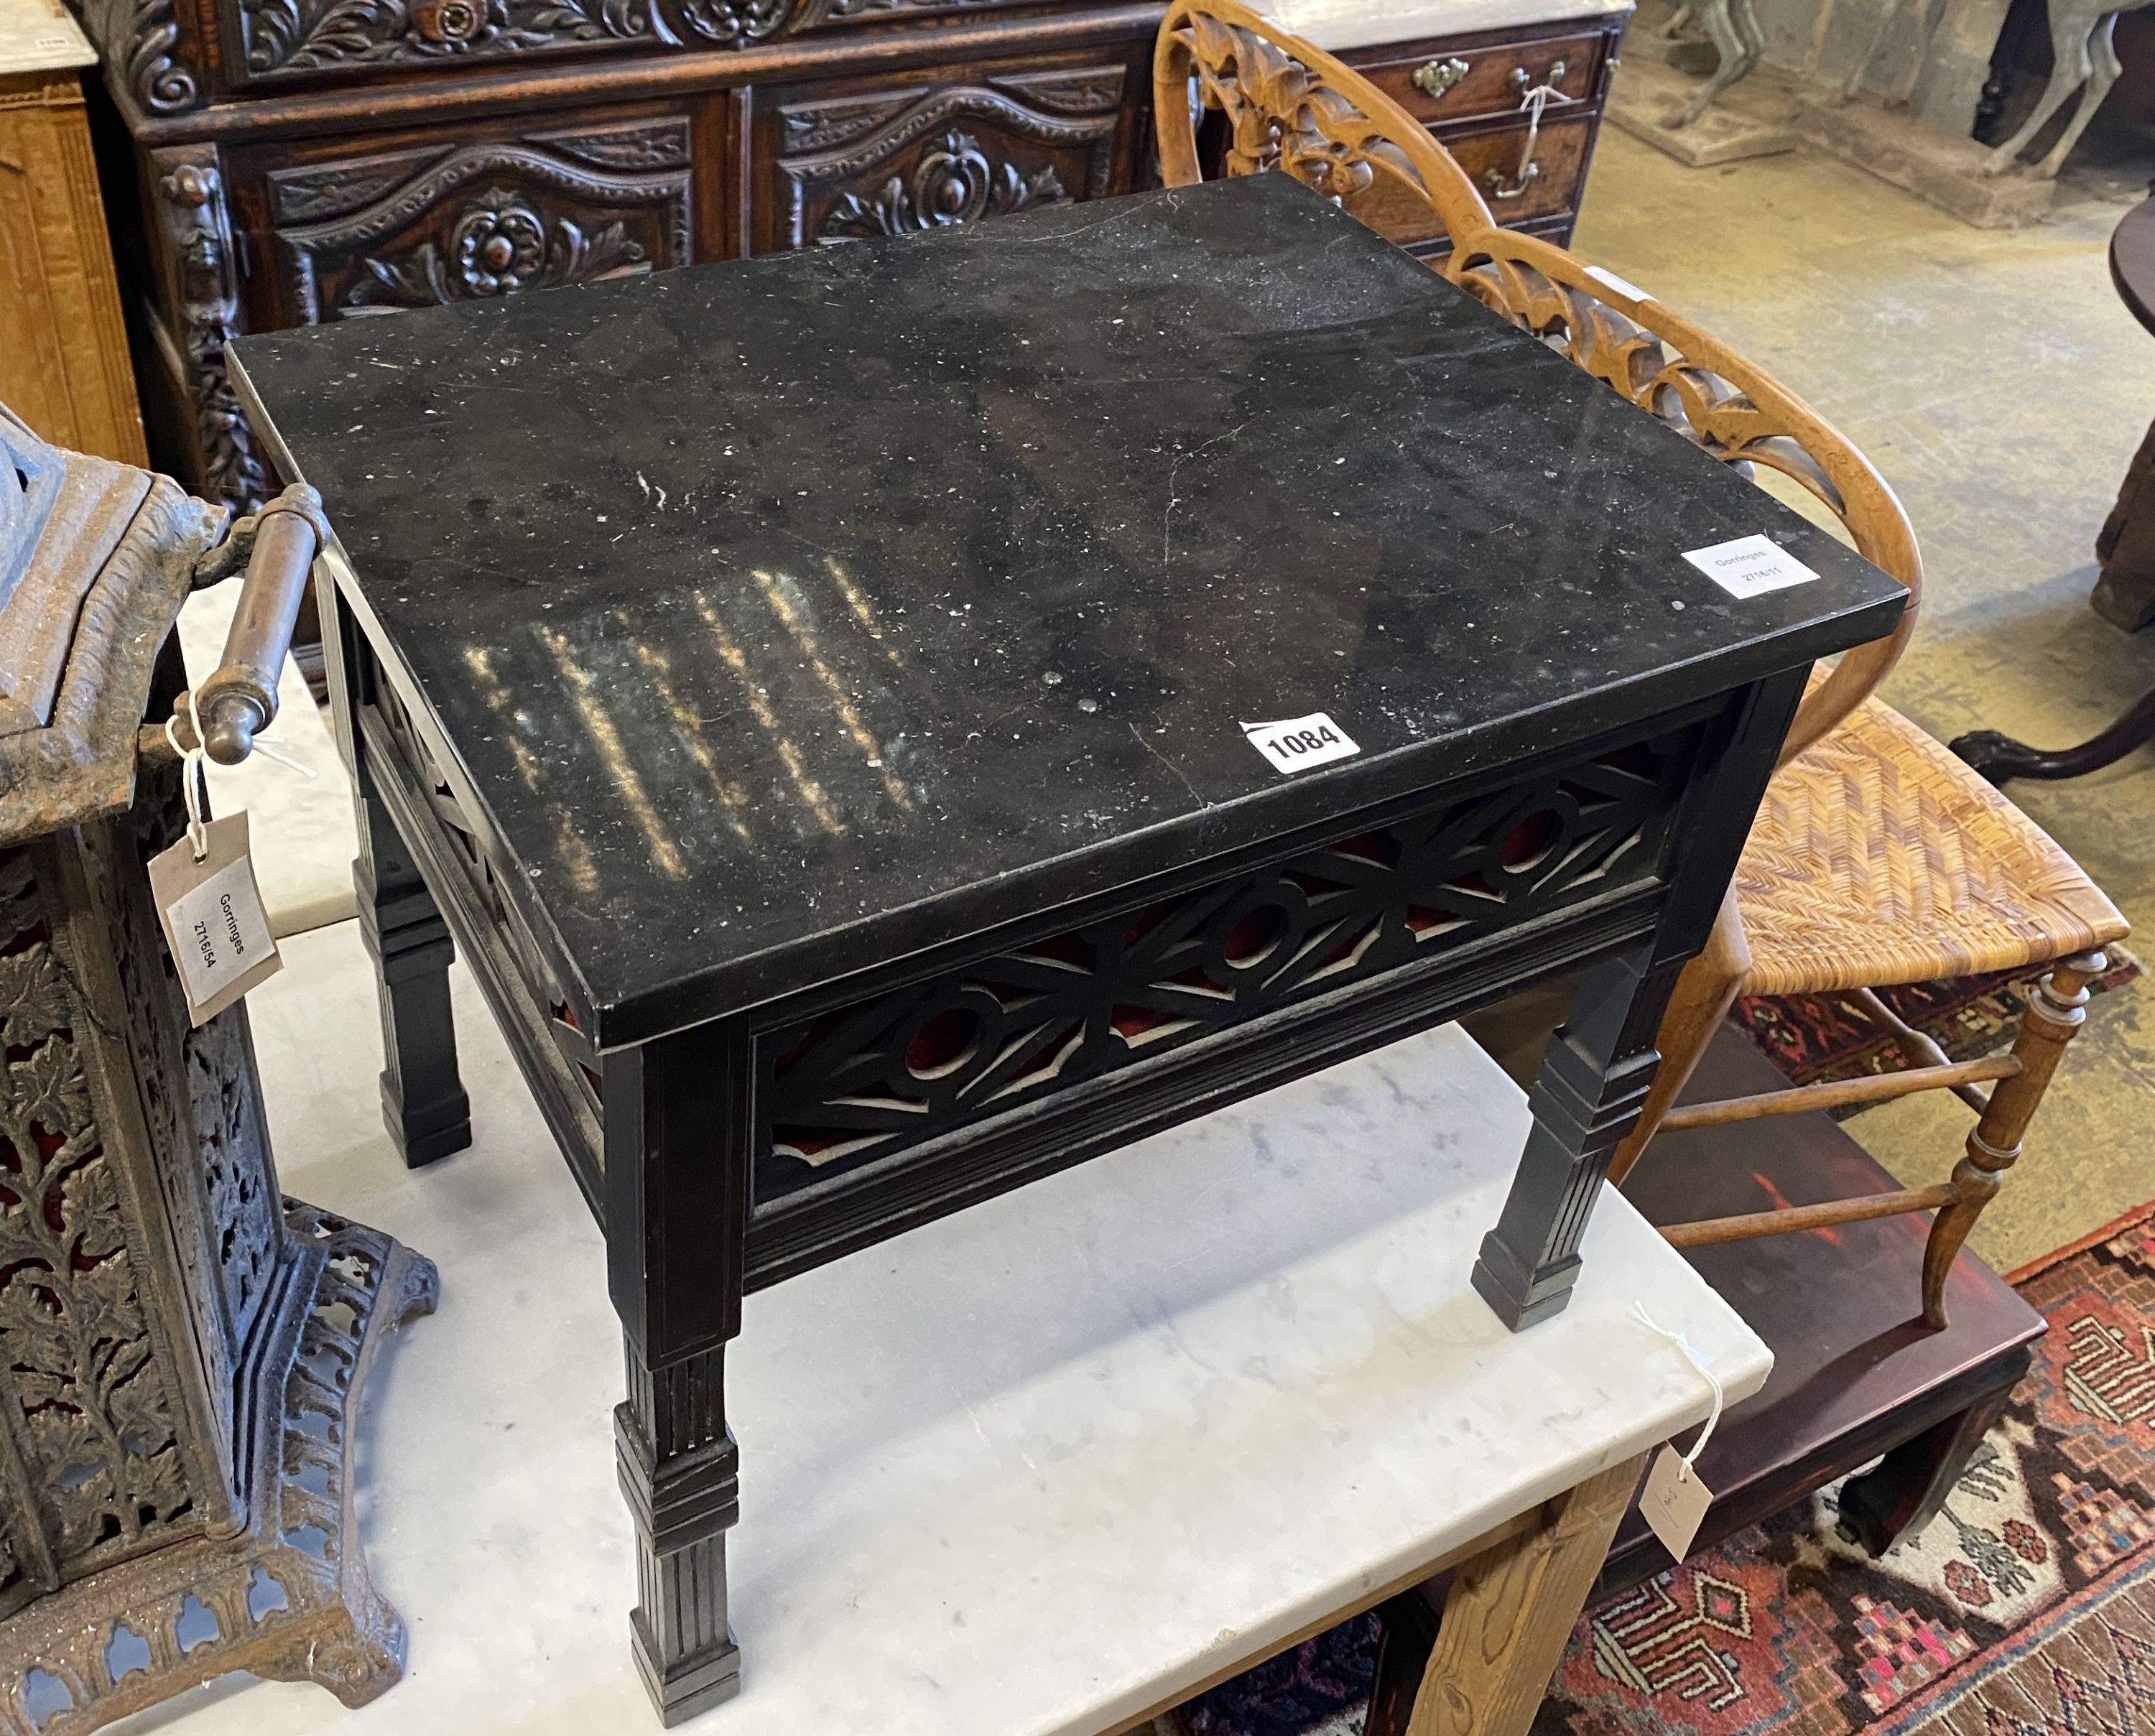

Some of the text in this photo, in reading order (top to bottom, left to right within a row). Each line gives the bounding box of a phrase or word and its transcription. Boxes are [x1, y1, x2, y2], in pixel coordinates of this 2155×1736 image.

[1715, 550, 1767, 567] Gorringes
[1266, 725, 1341, 758] 1084
[220, 893, 244, 955] Gorringes
[194, 921, 216, 968] 2716/54
